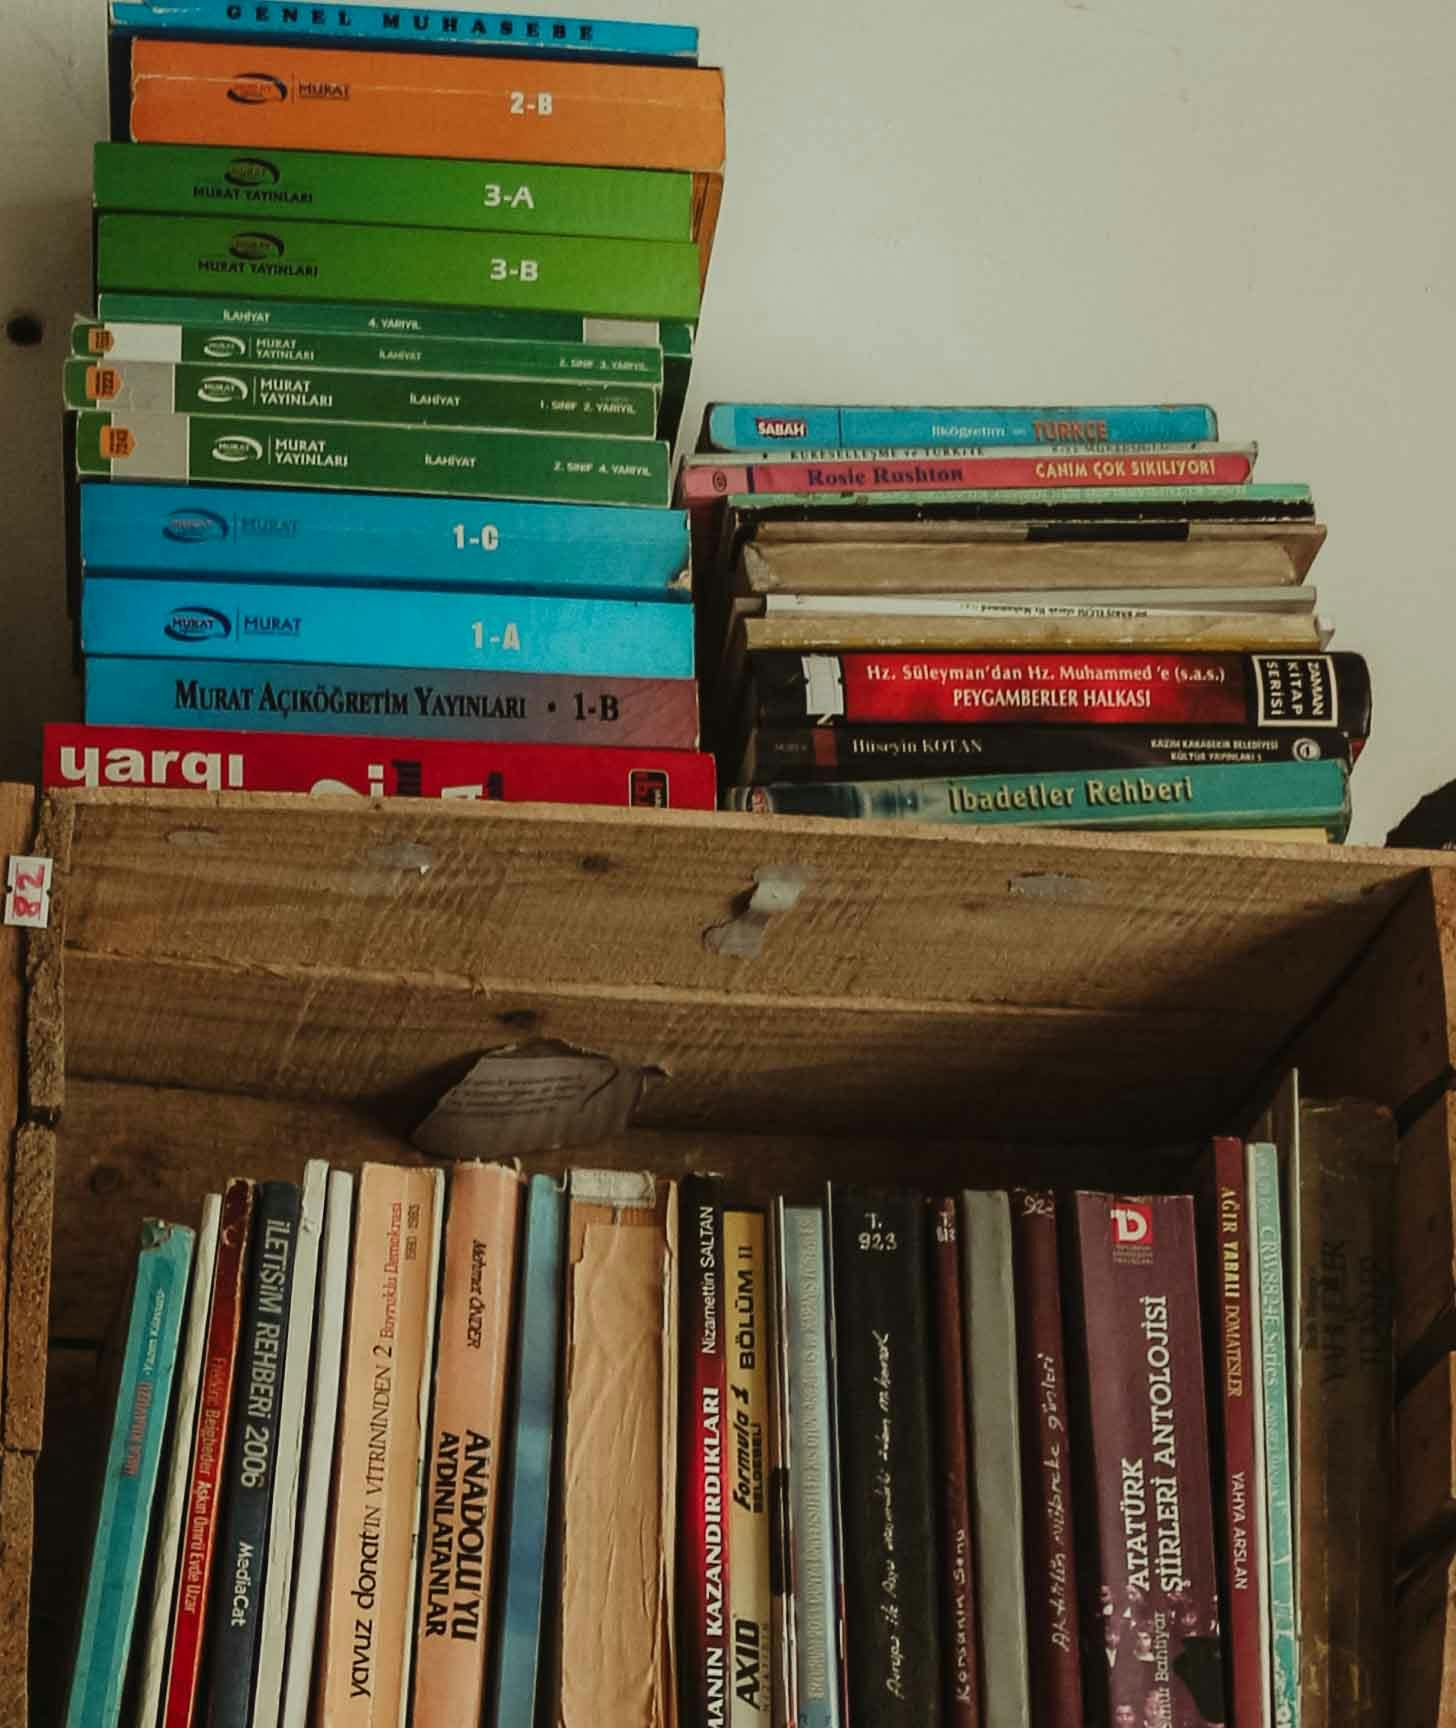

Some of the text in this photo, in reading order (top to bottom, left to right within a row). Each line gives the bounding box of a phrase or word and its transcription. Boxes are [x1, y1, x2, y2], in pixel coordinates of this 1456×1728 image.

[226, 5, 594, 42] GENEL MUHASEBE
[510, 91, 553, 116] 2-B
[484, 184, 535, 209] 3-A
[490, 258, 539, 283] 3-B
[260, 379, 311, 393] MURAT
[260, 392, 333, 408] YAYINLARI
[757, 419, 806, 438] SABAH
[275, 440, 326, 452] MURAT
[275, 451, 348, 468] YAYINLARI
[808, 464, 963, 485] Rosie Rushton
[1035, 462, 1088, 479] CANIM
[1093, 461, 1125, 480] ÇOK
[453, 523, 499, 550] 1-C
[471, 621, 520, 651] 1-A
[867, 664, 897, 682] Hz.
[902, 663, 1023, 685] Süleyman'dan
[1027, 664, 1057, 682] Hz.
[1059, 664, 1152, 682] Muhammed
[175, 679, 525, 719] MURAT AÇIKÖĞRETİM YAYINLARI
[953, 688, 1150, 709] PEYGAMBERLER HALKASI
[60, 746, 243, 788] yargı
[947, 775, 1192, 815] İbadetler Rehberi
[698, 1207, 715, 1267] SALTAN
[699, 1271, 717, 1354] Nizamettin
[733, 1270, 755, 1369] BÖLÜM
[231, 1219, 292, 1626] İLETİŞİM REHBERİ 2006 MediaCat
[1139, 1295, 1191, 1592] ŞİİRLERİ ANTOLOJİSİ
[704, 1387, 724, 1636] KAZANDIRDIKLARI
[1122, 1459, 1151, 1589] ATATÜRK
[425, 1431, 459, 1636] AYDINLATANLAR
[735, 1618, 760, 1710] AXID
